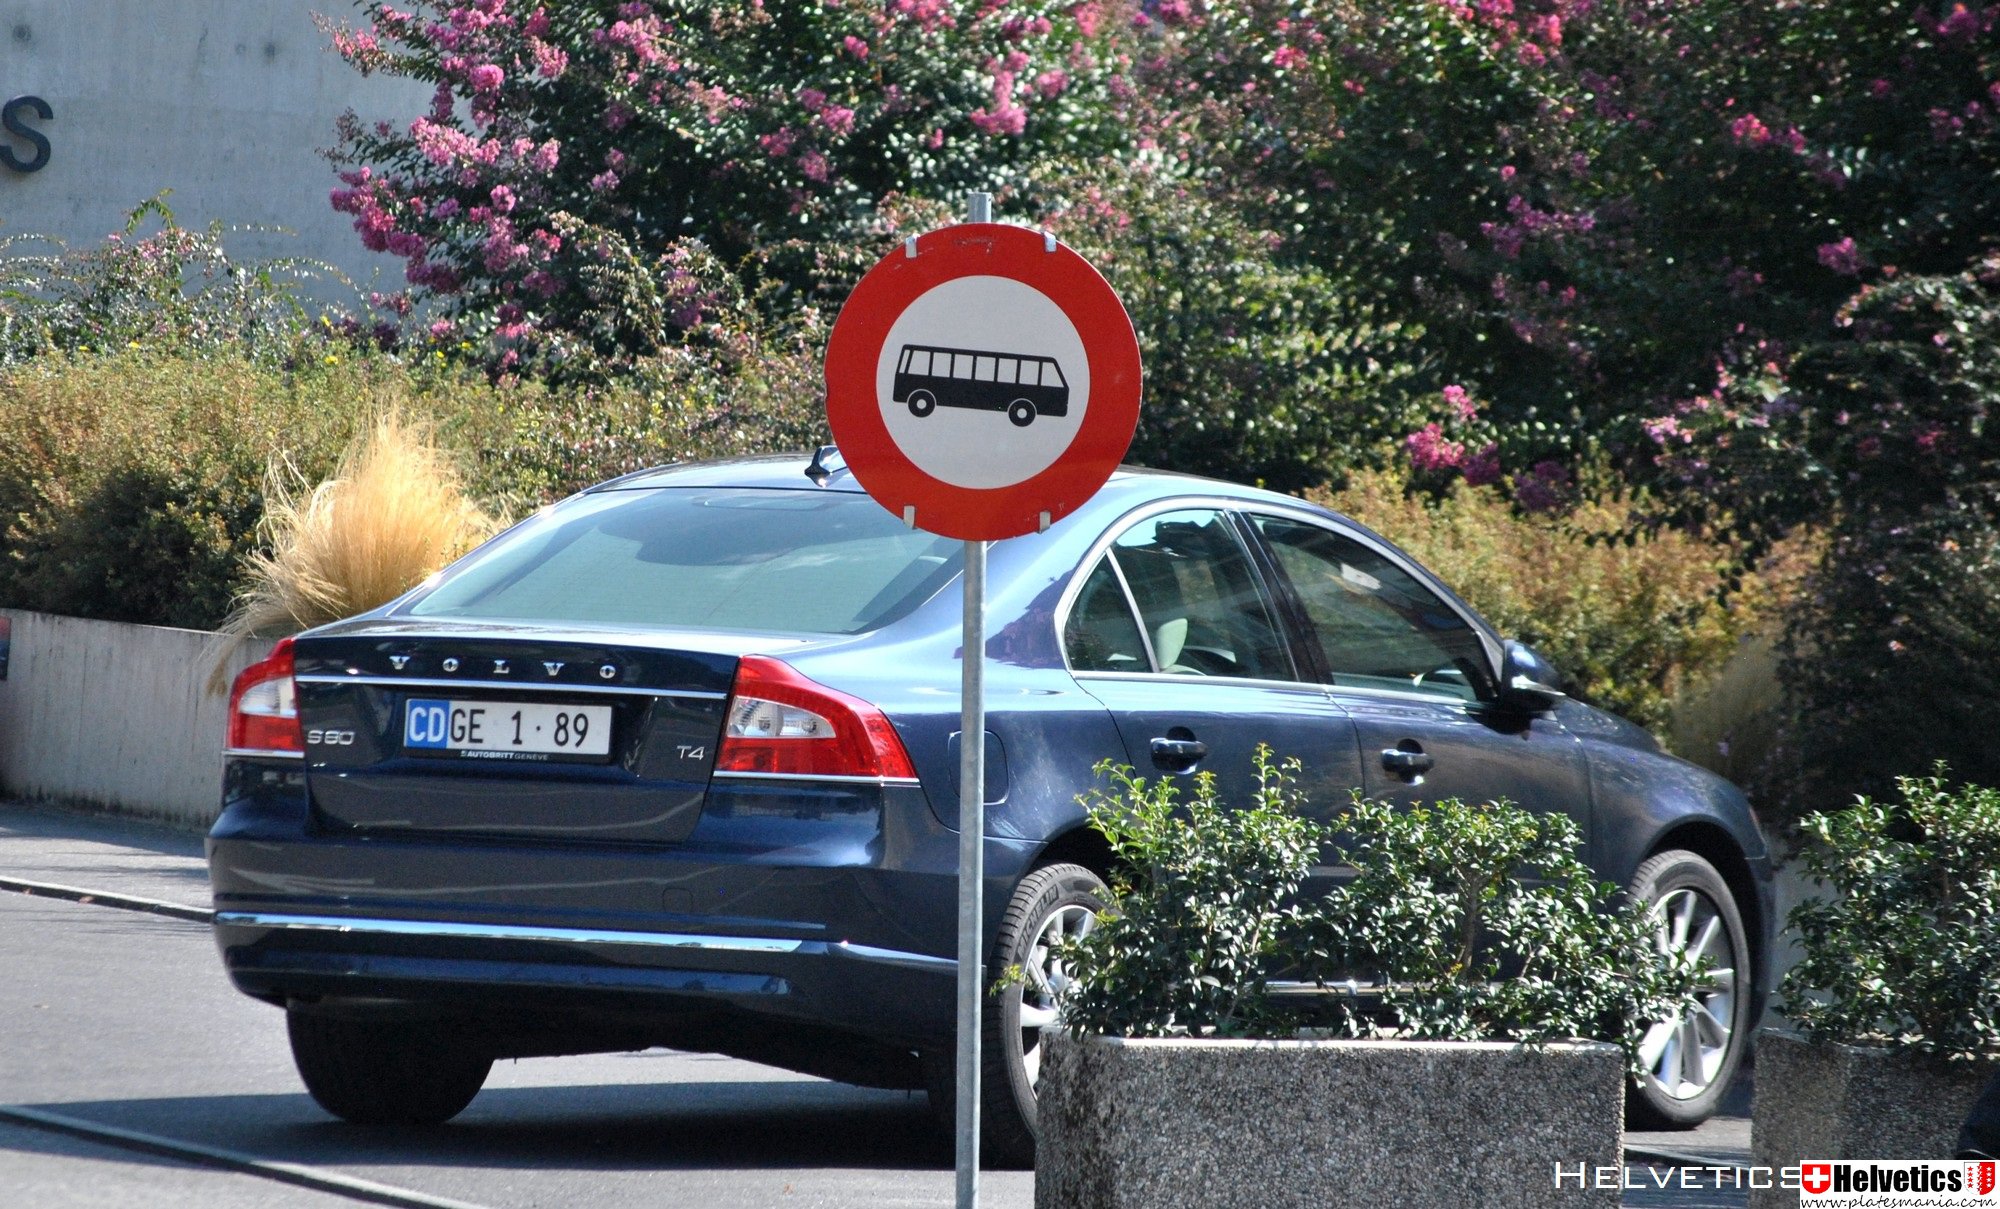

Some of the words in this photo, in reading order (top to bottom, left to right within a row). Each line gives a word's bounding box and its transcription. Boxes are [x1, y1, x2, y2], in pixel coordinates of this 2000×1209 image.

[389, 655, 616, 679] VOLVO
[307, 729, 355, 746] S80
[409, 706, 446, 744] CD
[450, 708, 486, 745] GE
[510, 711, 523, 745] 1
[554, 712, 590, 749] 89
[676, 745, 705, 761] T4
[1017, 884, 1059, 959] MICHELIN
